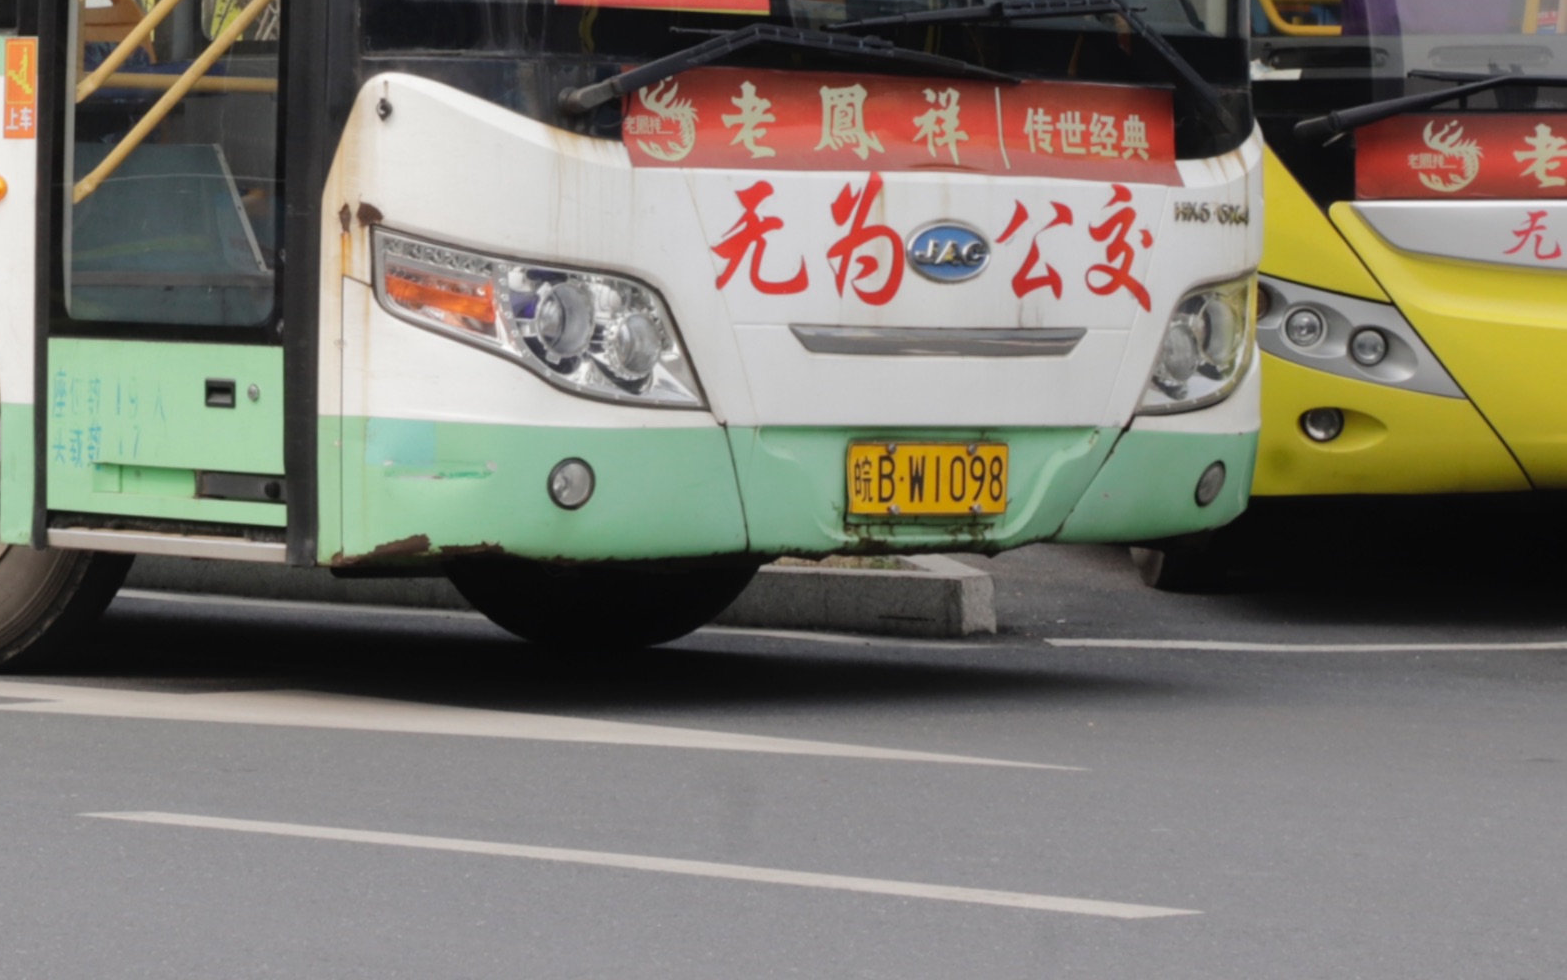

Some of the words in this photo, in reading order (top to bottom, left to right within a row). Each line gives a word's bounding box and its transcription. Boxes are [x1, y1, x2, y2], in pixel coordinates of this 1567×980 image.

[5, 107, 32, 131] 上车
[1023, 107, 1149, 160] 传世经典
[1513, 123, 1567, 188] 老
[914, 239, 984, 267] JAC
[1502, 210, 1562, 260] 无
[854, 455, 1004, 503] 皖B·W1098
